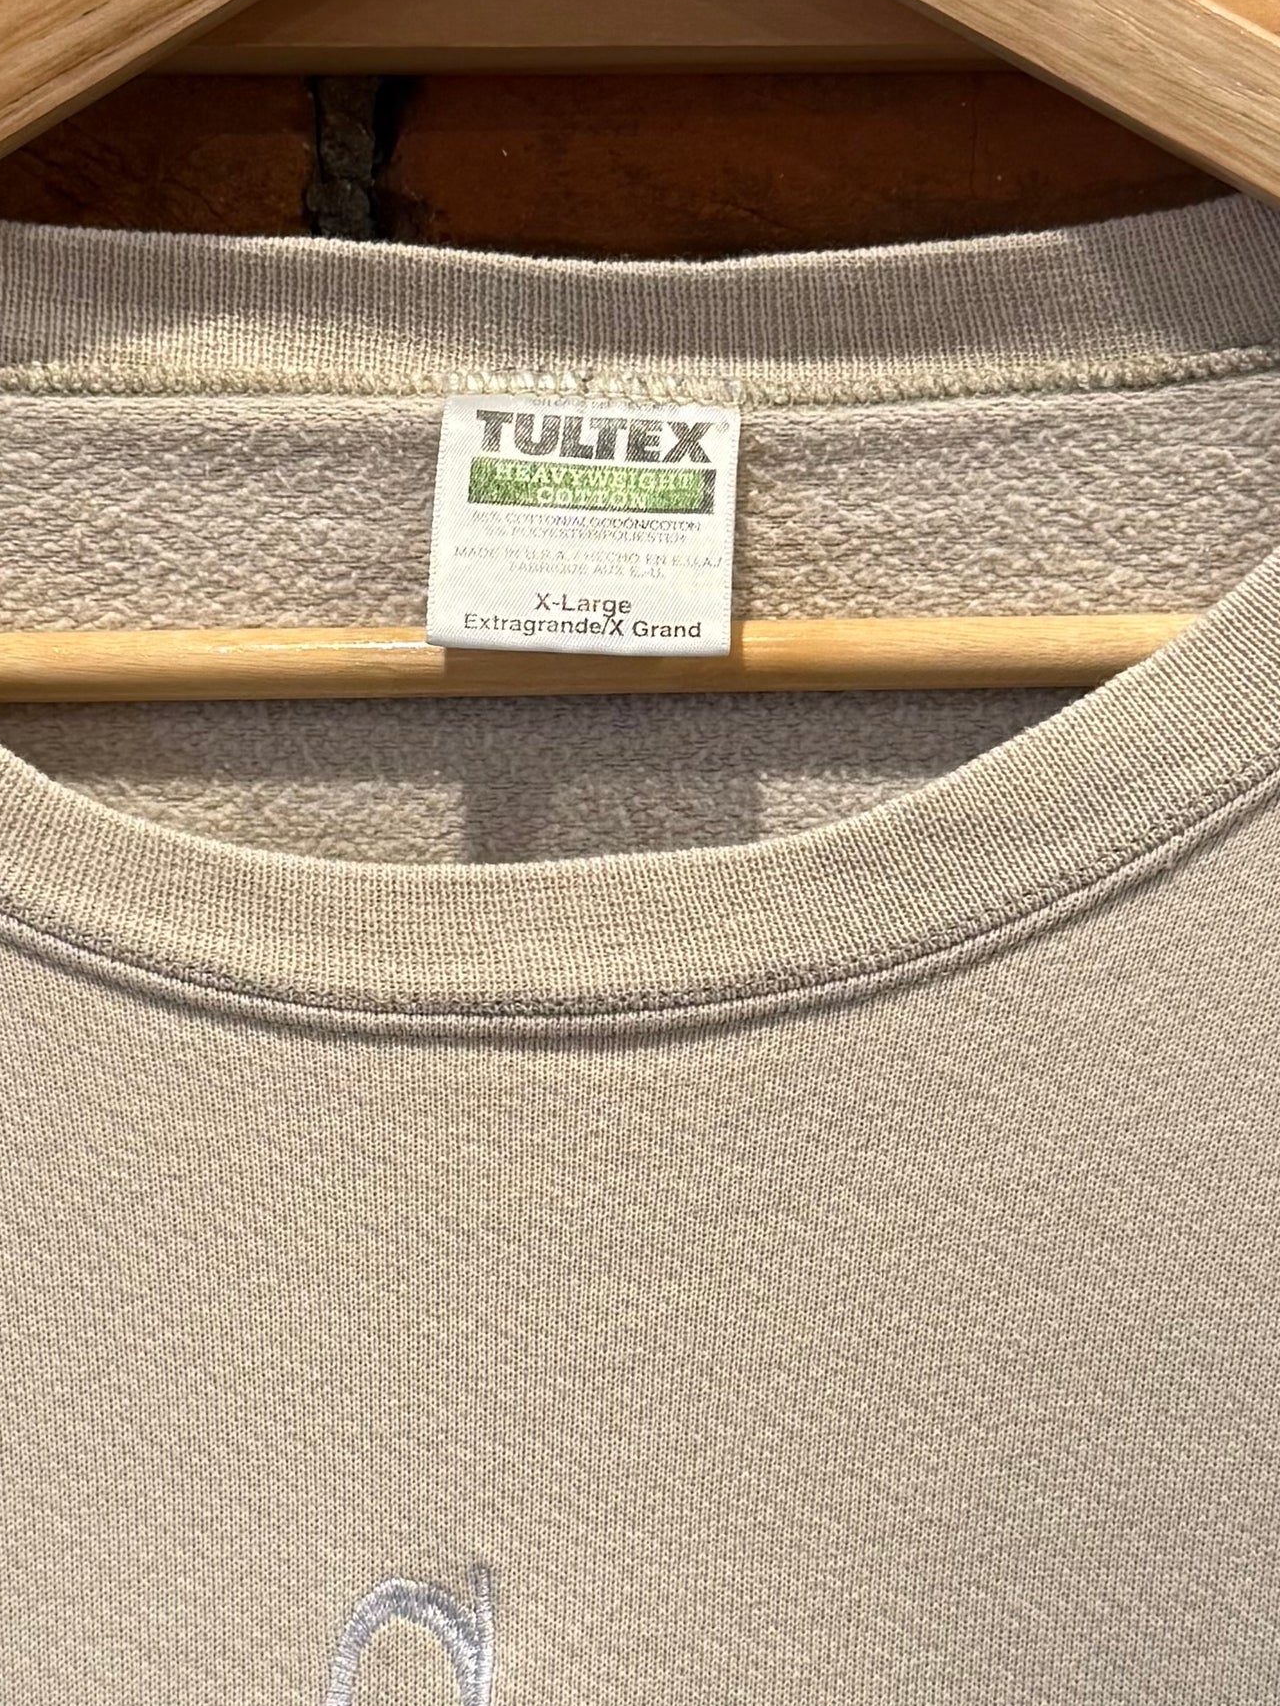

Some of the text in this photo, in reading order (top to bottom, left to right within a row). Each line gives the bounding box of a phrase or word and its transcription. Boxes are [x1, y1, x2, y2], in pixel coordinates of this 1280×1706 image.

[476, 409, 713, 464] TULTEX
[494, 461, 694, 490] HEAVYWEIGHT
[536, 486, 648, 508] COTTON
[534, 592, 632, 618] X-Large
[464, 612, 702, 638] Extragrande/X Grand
